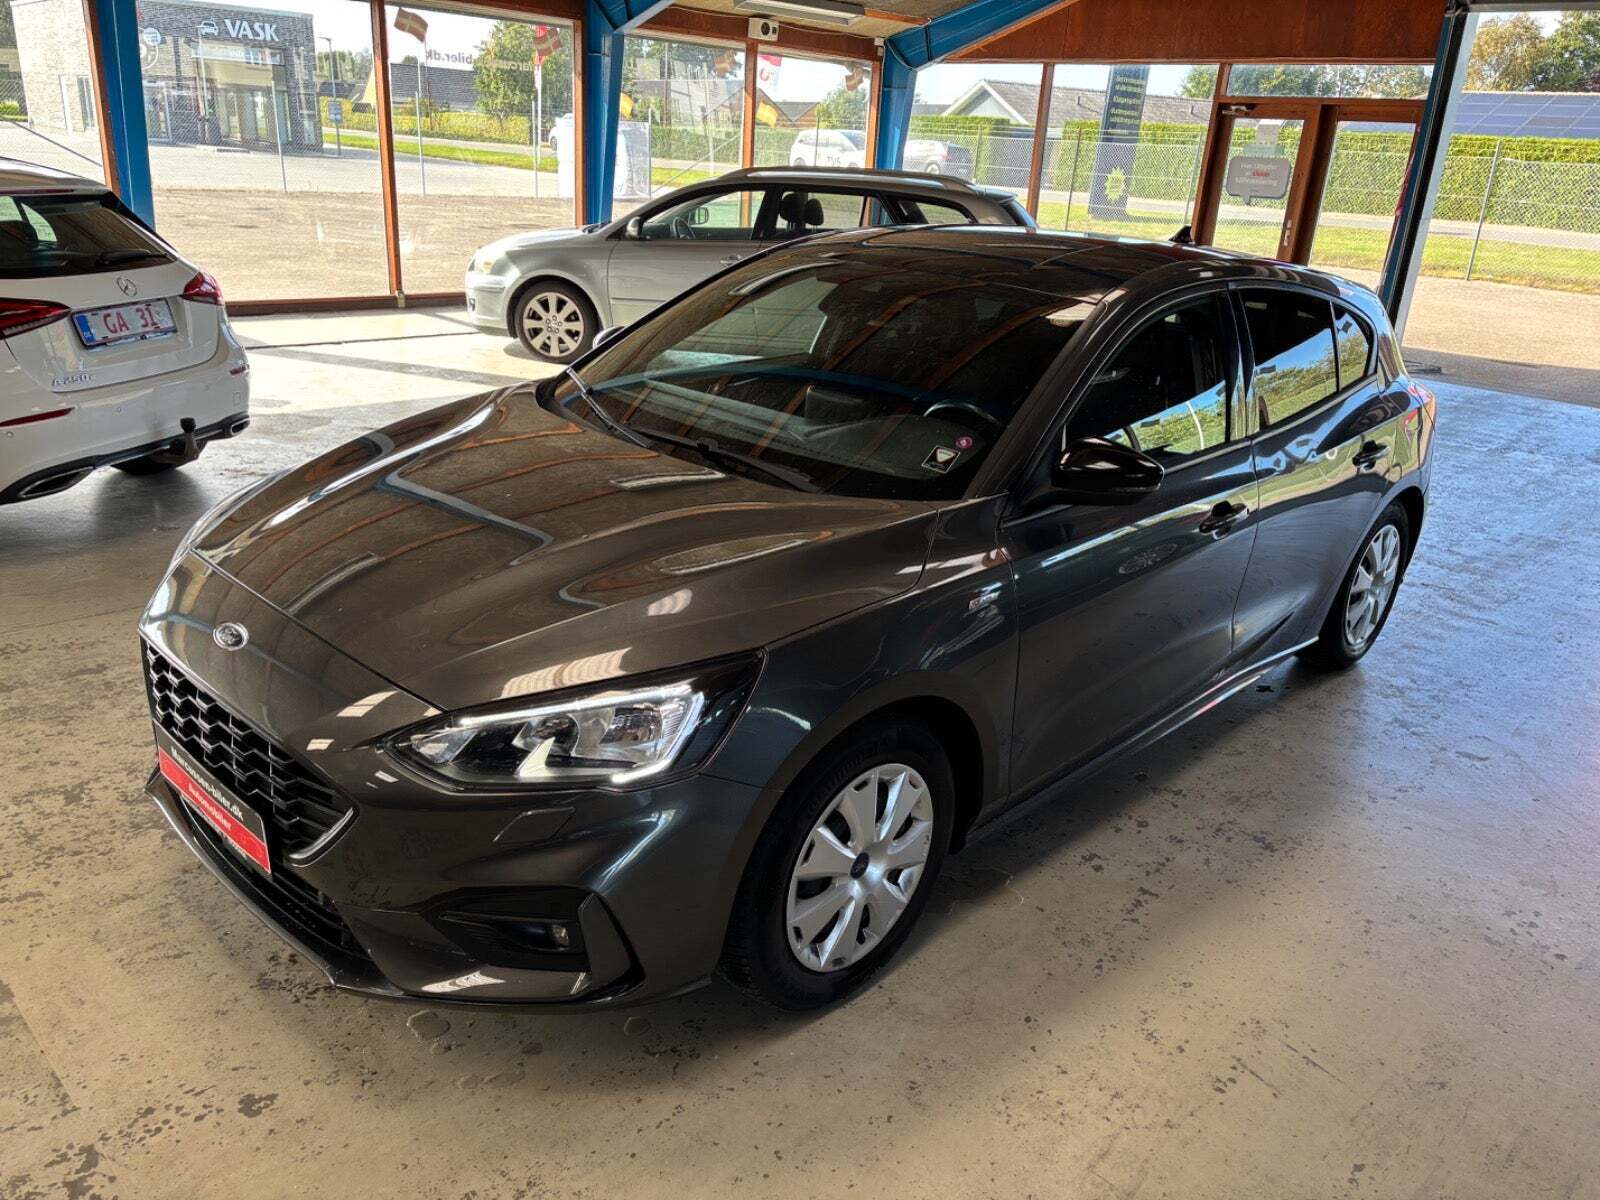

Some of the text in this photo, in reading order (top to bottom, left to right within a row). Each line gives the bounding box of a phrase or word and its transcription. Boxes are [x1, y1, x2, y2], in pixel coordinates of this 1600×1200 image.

[224, 19, 279, 42] VASK
[103, 306, 158, 334] GA 31
